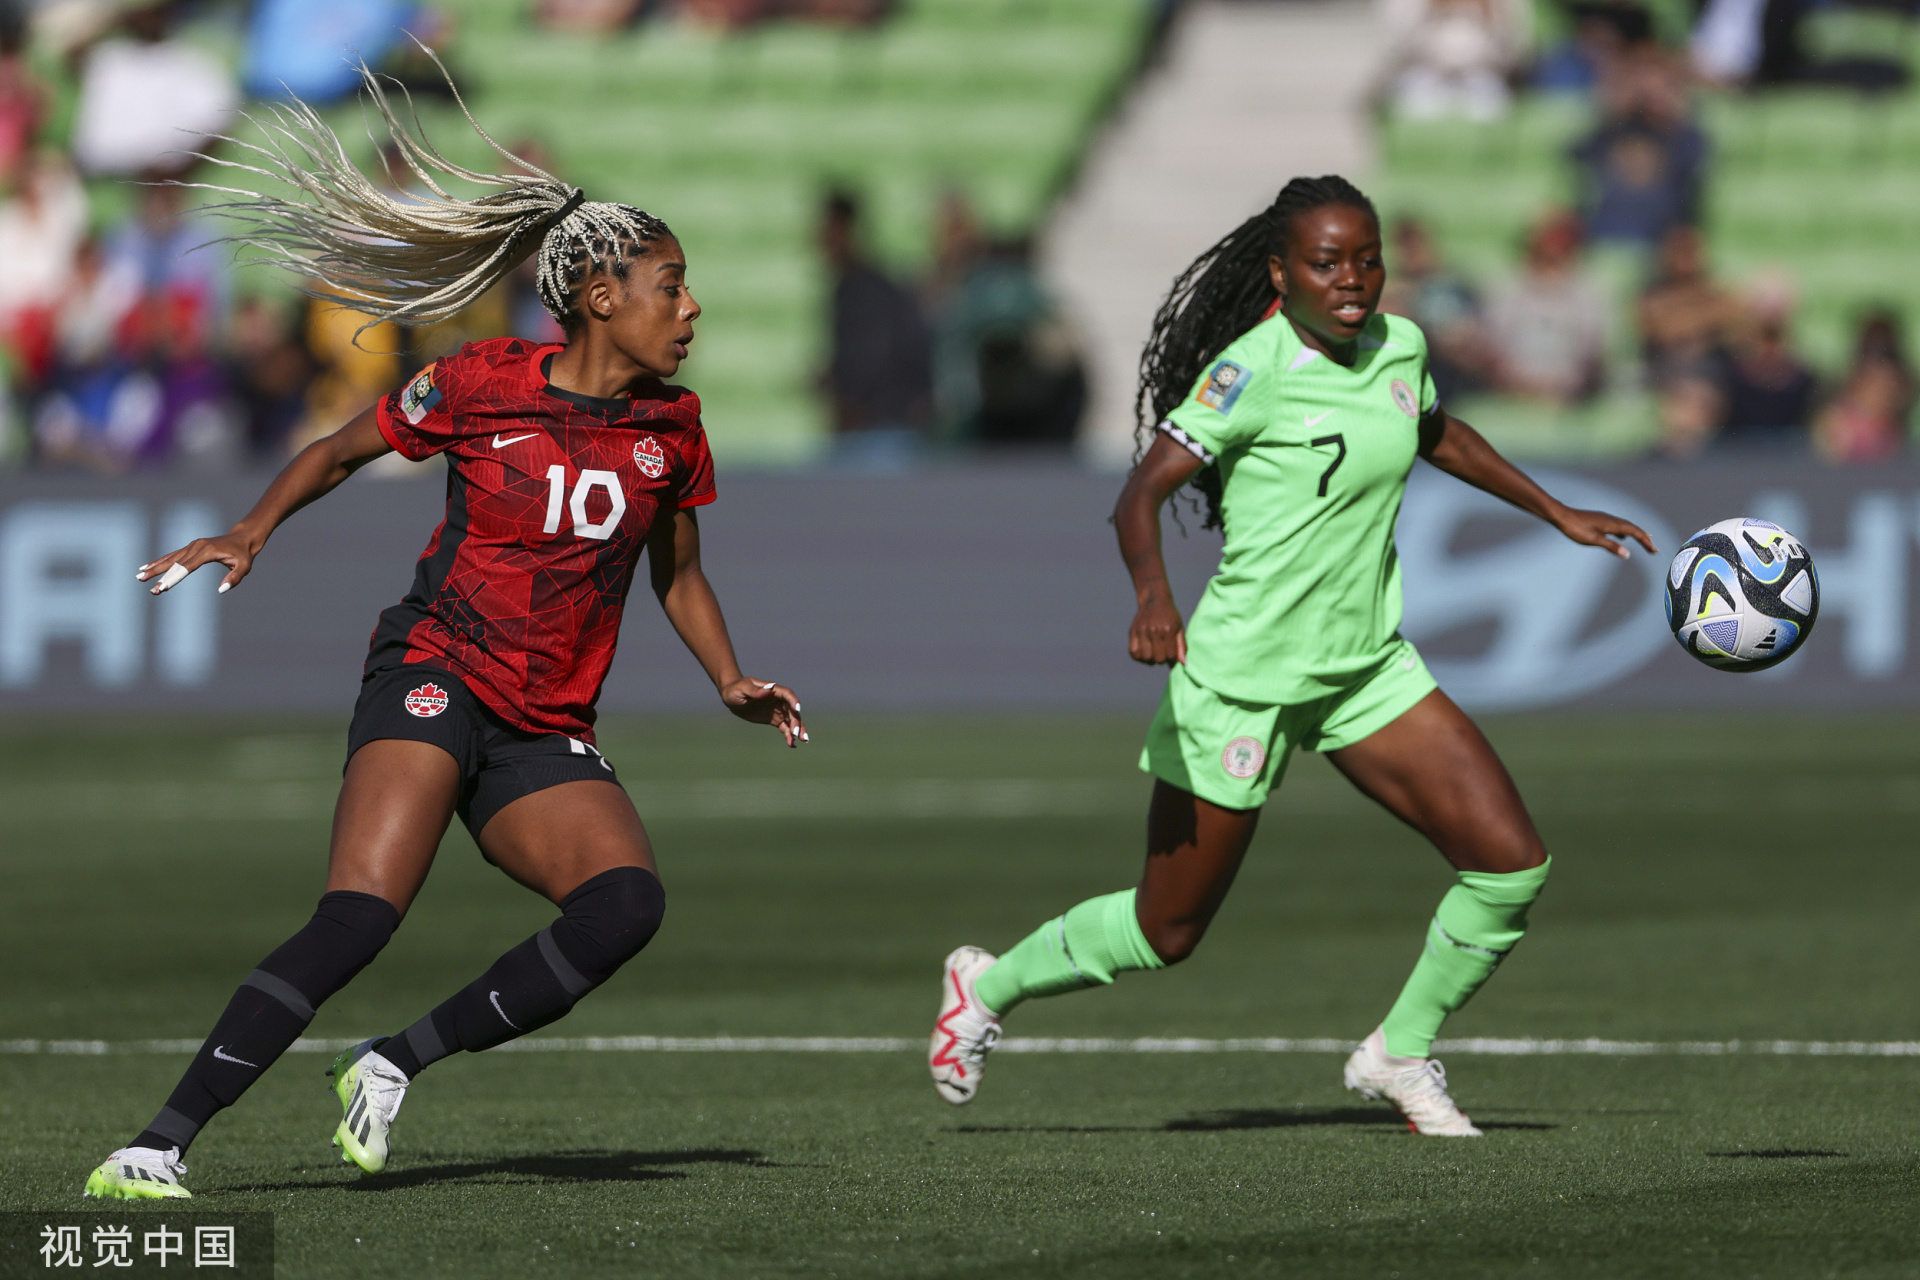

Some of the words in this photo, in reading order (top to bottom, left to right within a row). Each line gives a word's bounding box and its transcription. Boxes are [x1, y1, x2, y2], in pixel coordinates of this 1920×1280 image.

[634, 452, 663, 465] CANADA
[1312, 434, 1347, 497] 7
[542, 464, 627, 540] 10
[1750, 497, 1920, 680] H
[406, 697, 446, 706] CANADA
